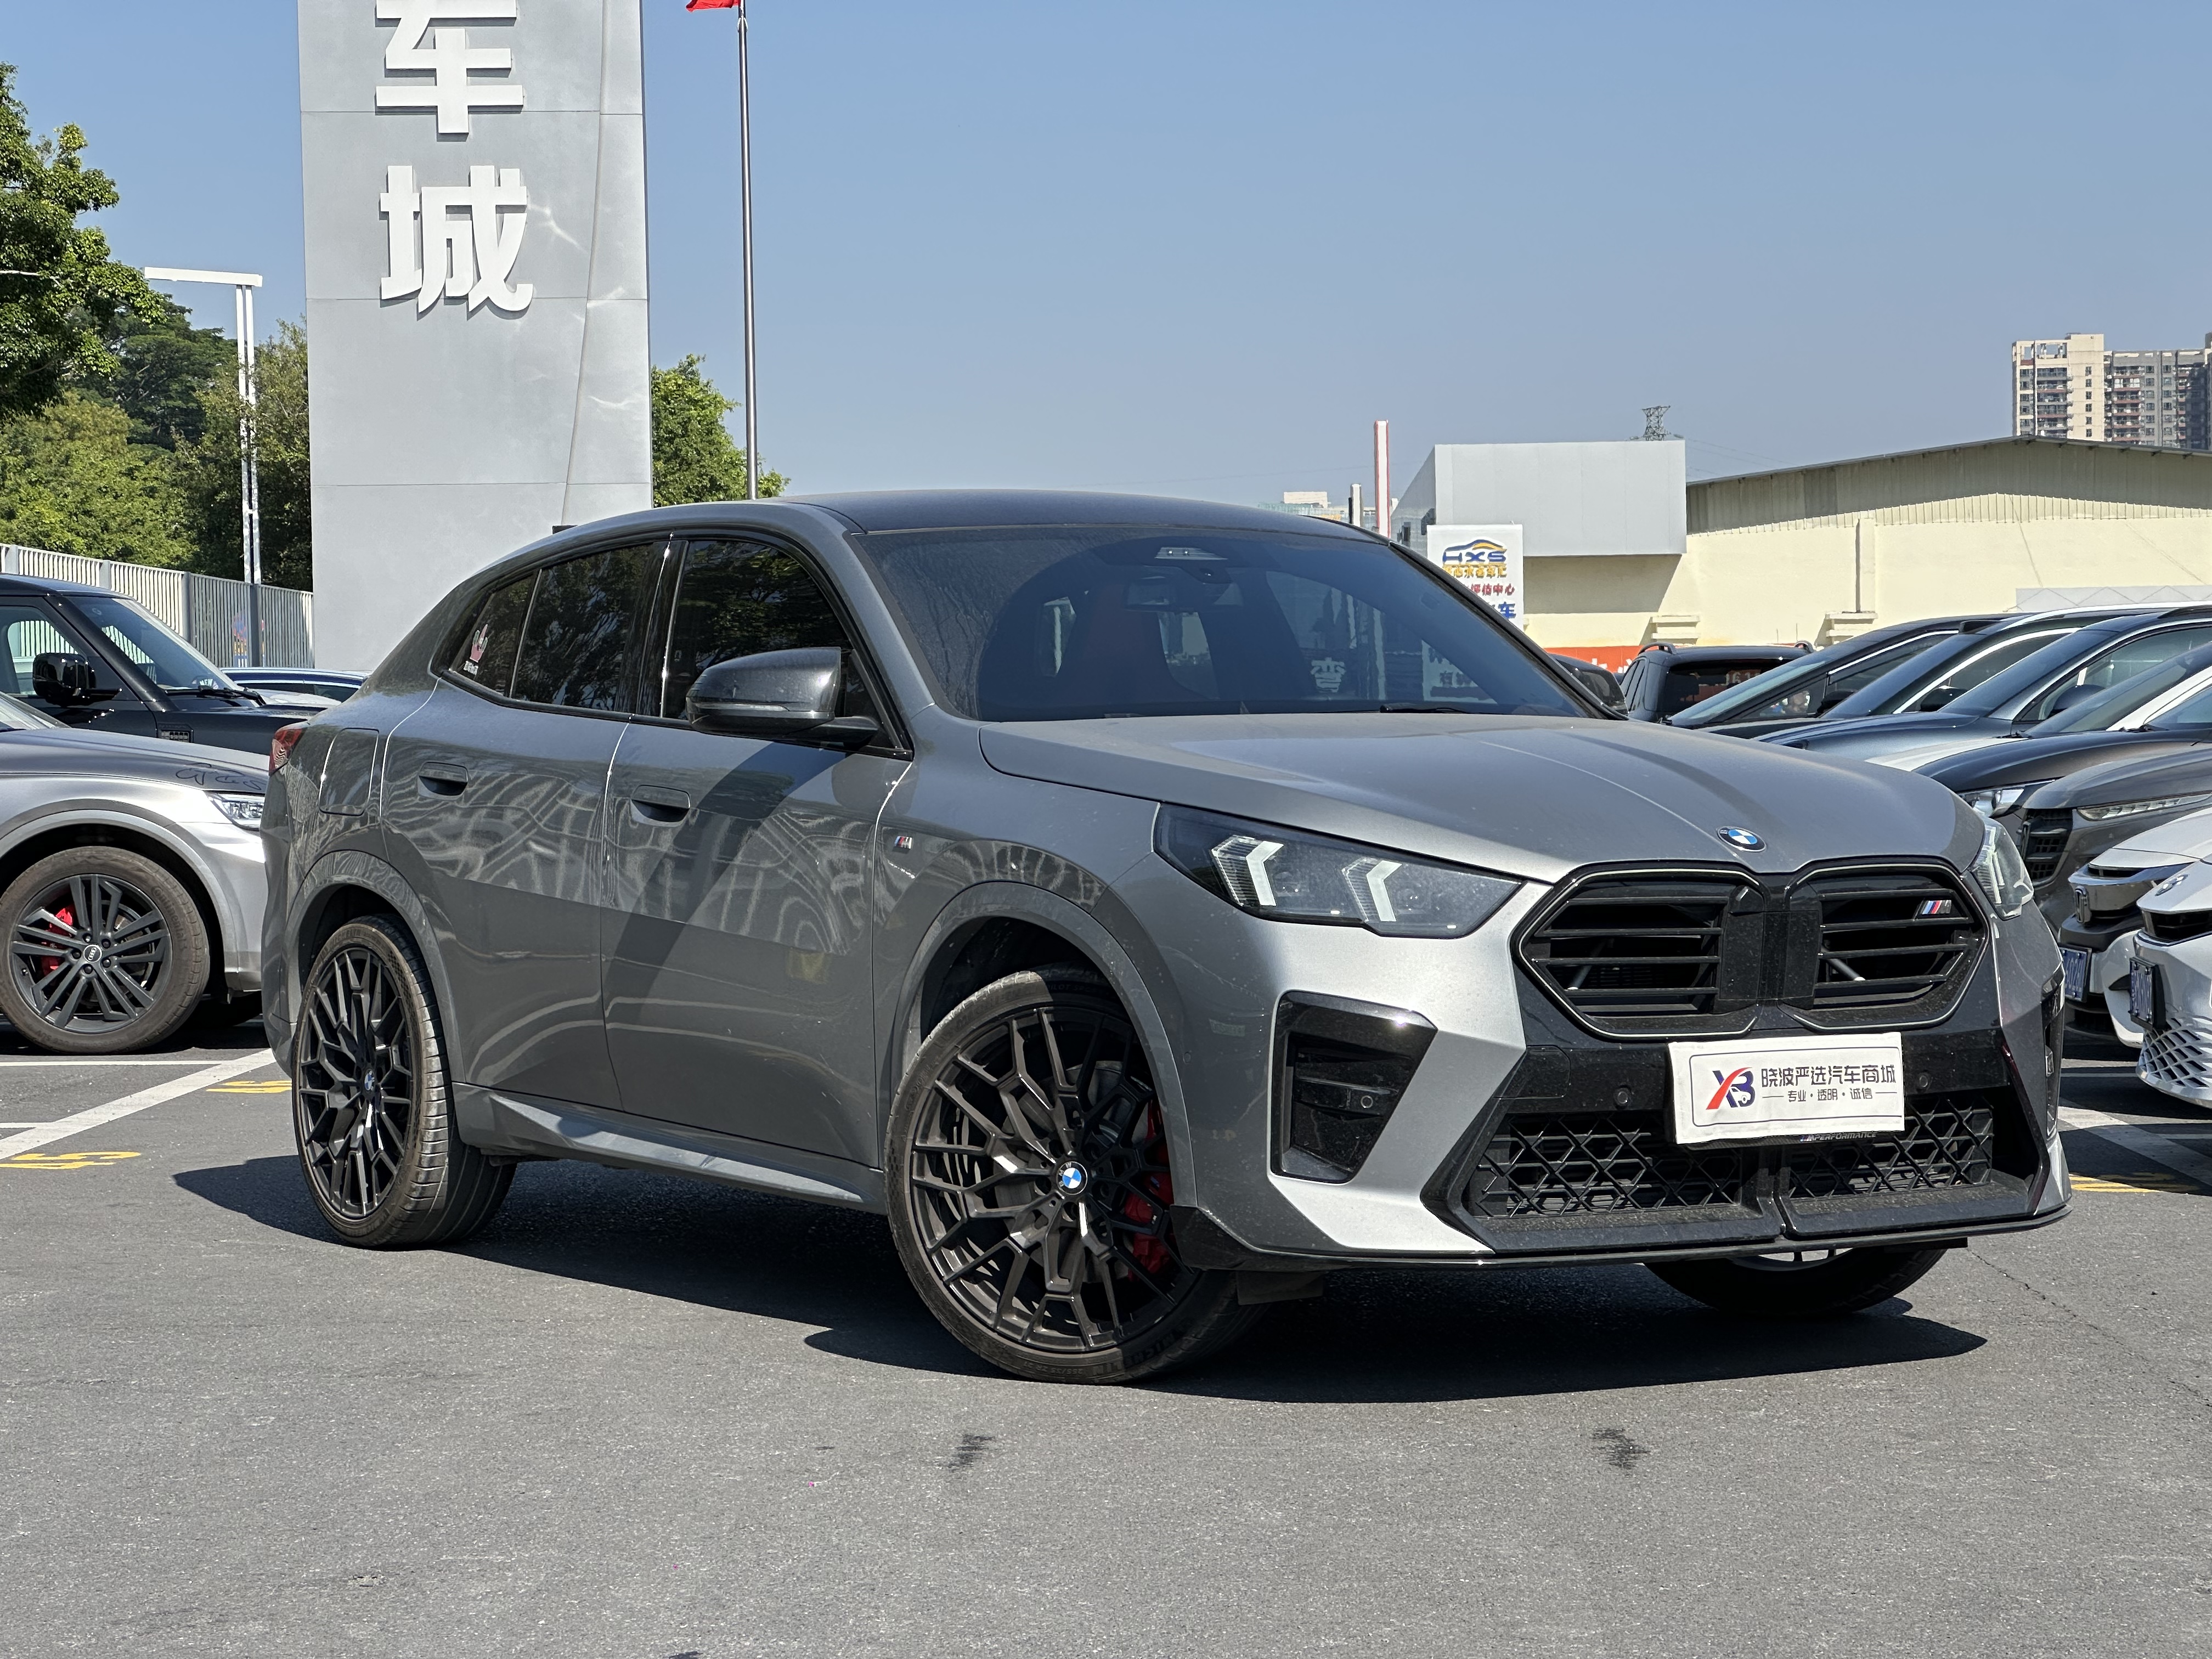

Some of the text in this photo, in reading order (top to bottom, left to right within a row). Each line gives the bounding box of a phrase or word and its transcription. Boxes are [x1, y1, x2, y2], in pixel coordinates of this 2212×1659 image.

[375, 0, 533, 313] 车城
[1464, 583, 1515, 596] 评估中心
[1761, 1064, 1897, 1088] 晓波严选汽车商城
